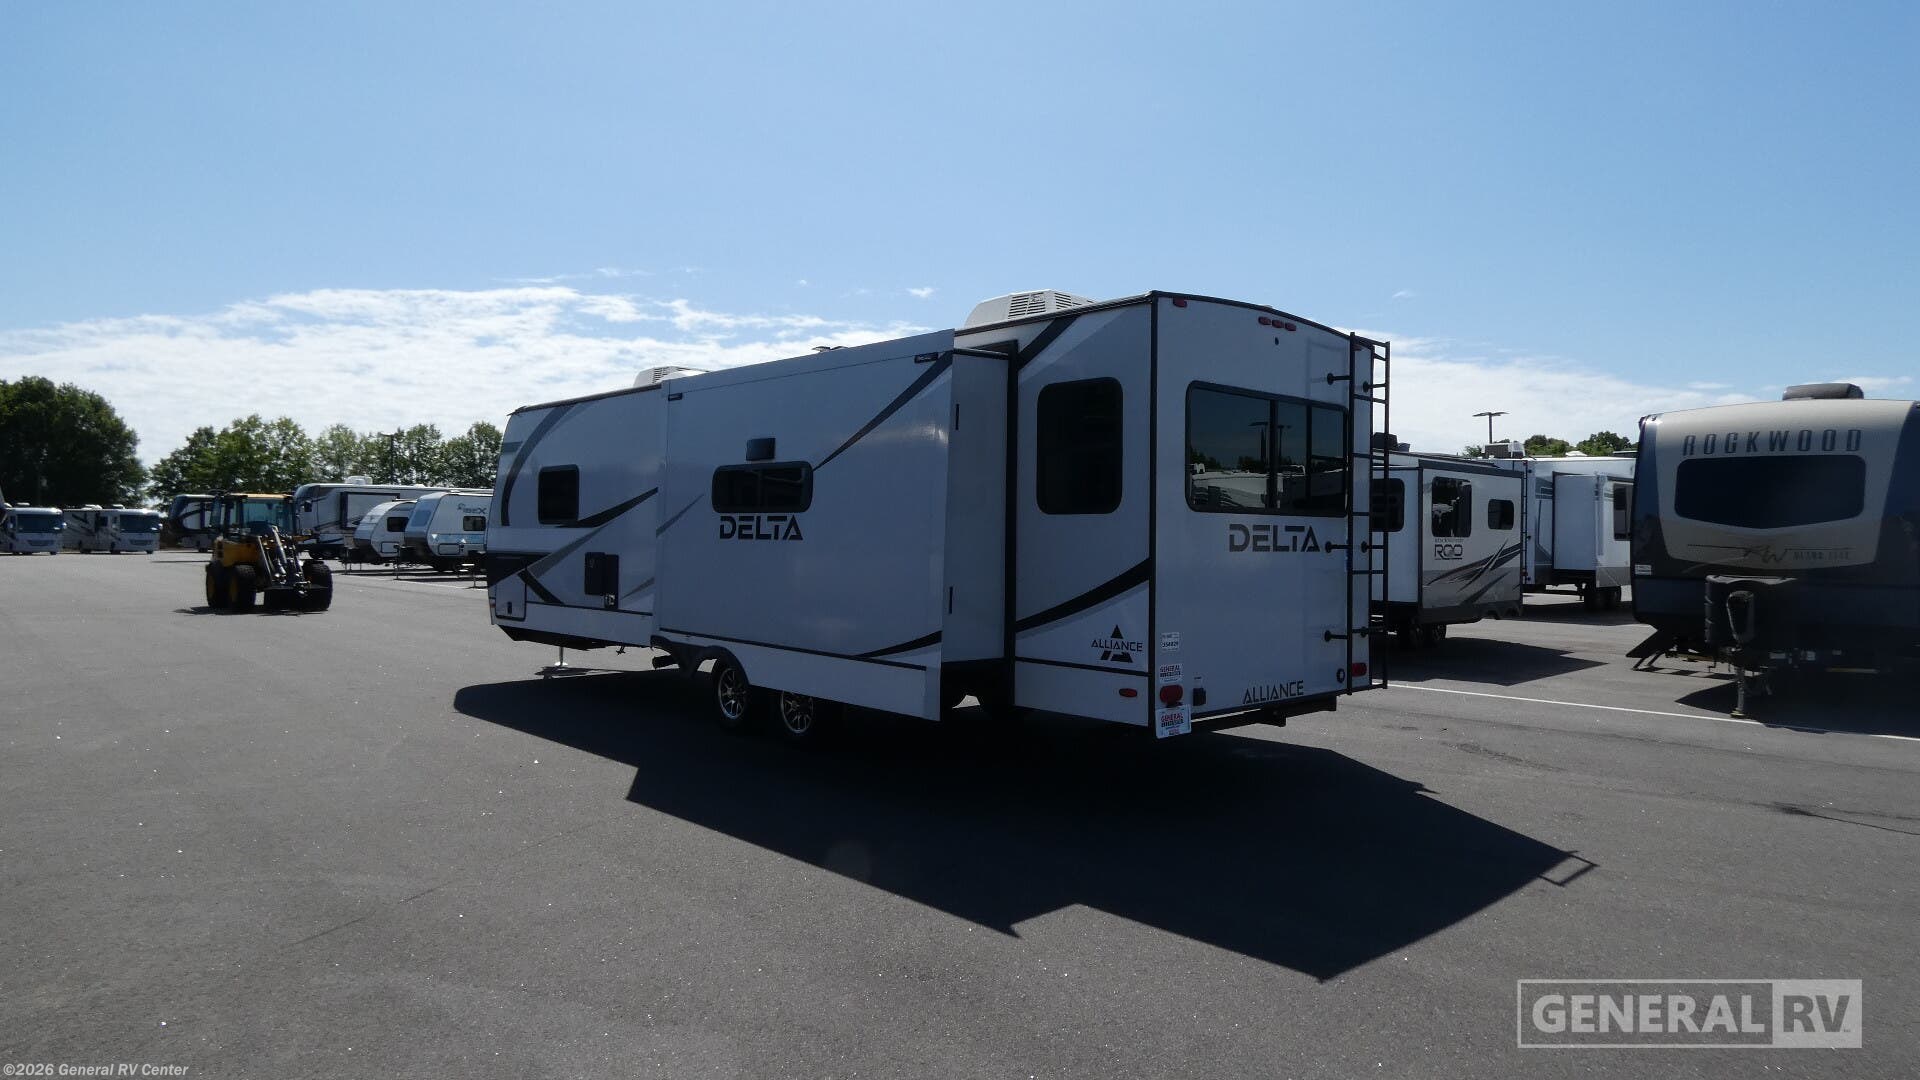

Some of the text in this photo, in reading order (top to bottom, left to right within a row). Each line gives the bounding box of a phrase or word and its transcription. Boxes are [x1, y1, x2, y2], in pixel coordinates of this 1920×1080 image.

[1682, 429, 1862, 456] ROCKWOOD
[719, 515, 803, 540] DELTA
[1229, 523, 1320, 552] DELTA
[1091, 640, 1143, 652] ALLIANCE
[1242, 680, 1304, 704] ALLIANCE
